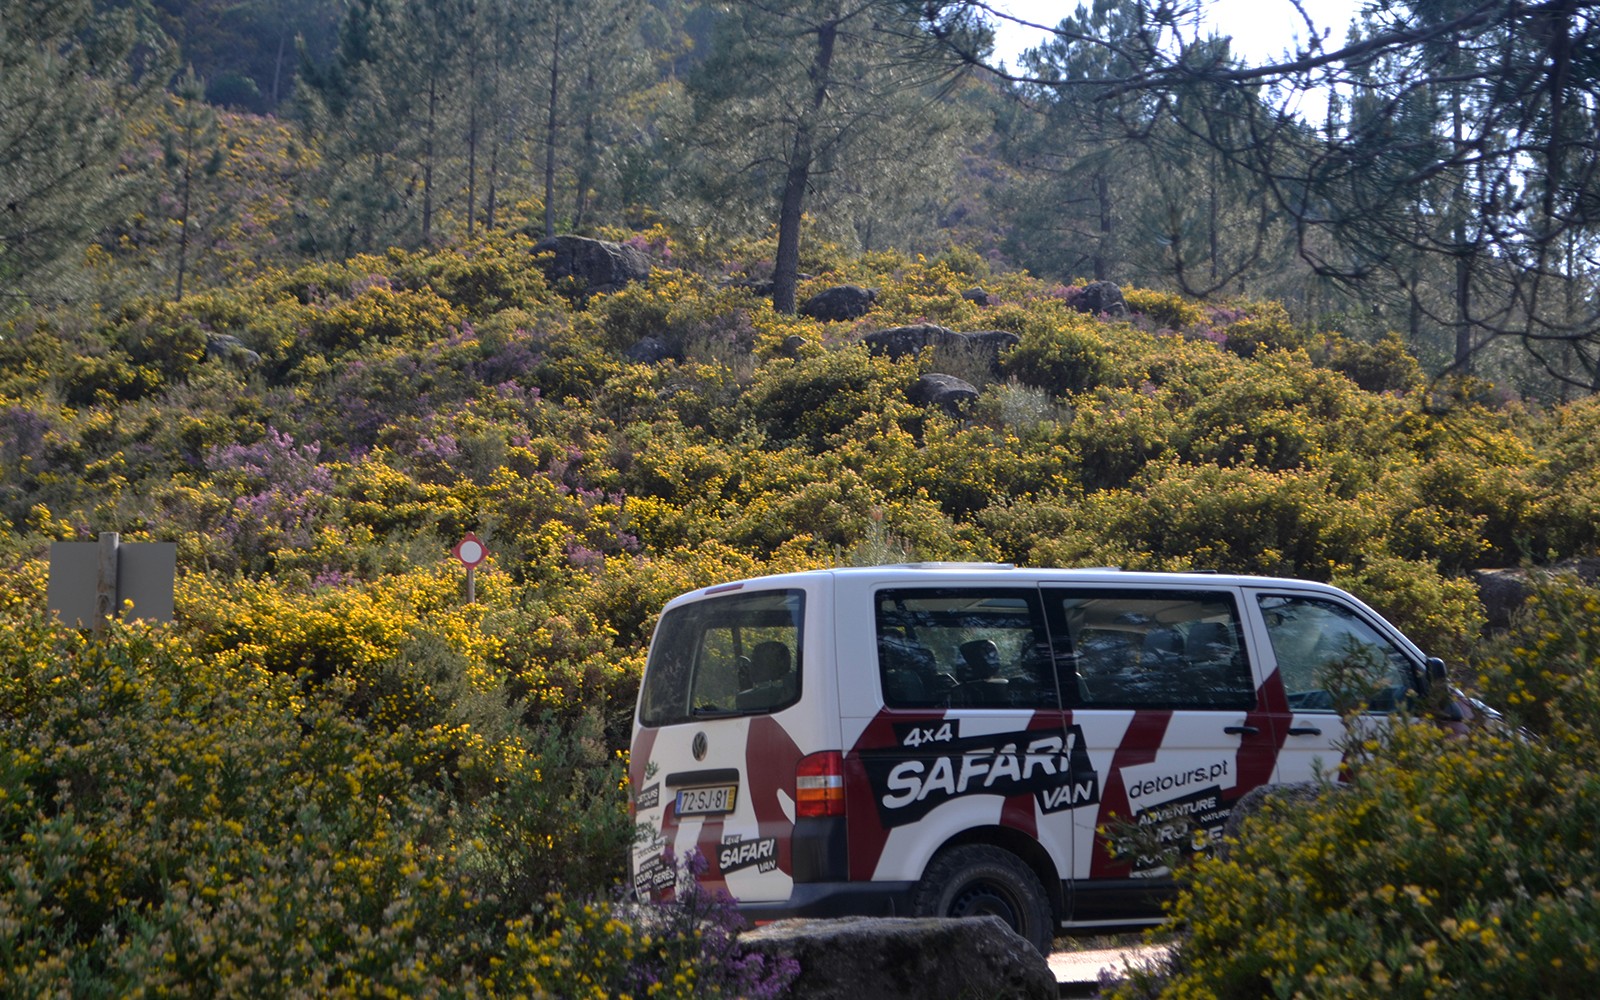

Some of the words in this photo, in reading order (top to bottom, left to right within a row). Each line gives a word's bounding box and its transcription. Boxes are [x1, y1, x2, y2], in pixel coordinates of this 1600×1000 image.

[903, 723, 952, 747] 4x4
[882, 733, 1076, 809] SAFARI
[1129, 760, 1228, 799] detours.pt
[1043, 780, 1093, 809] VAN
[719, 839, 775, 869] SAFARI
[759, 860, 776, 872] VAN
